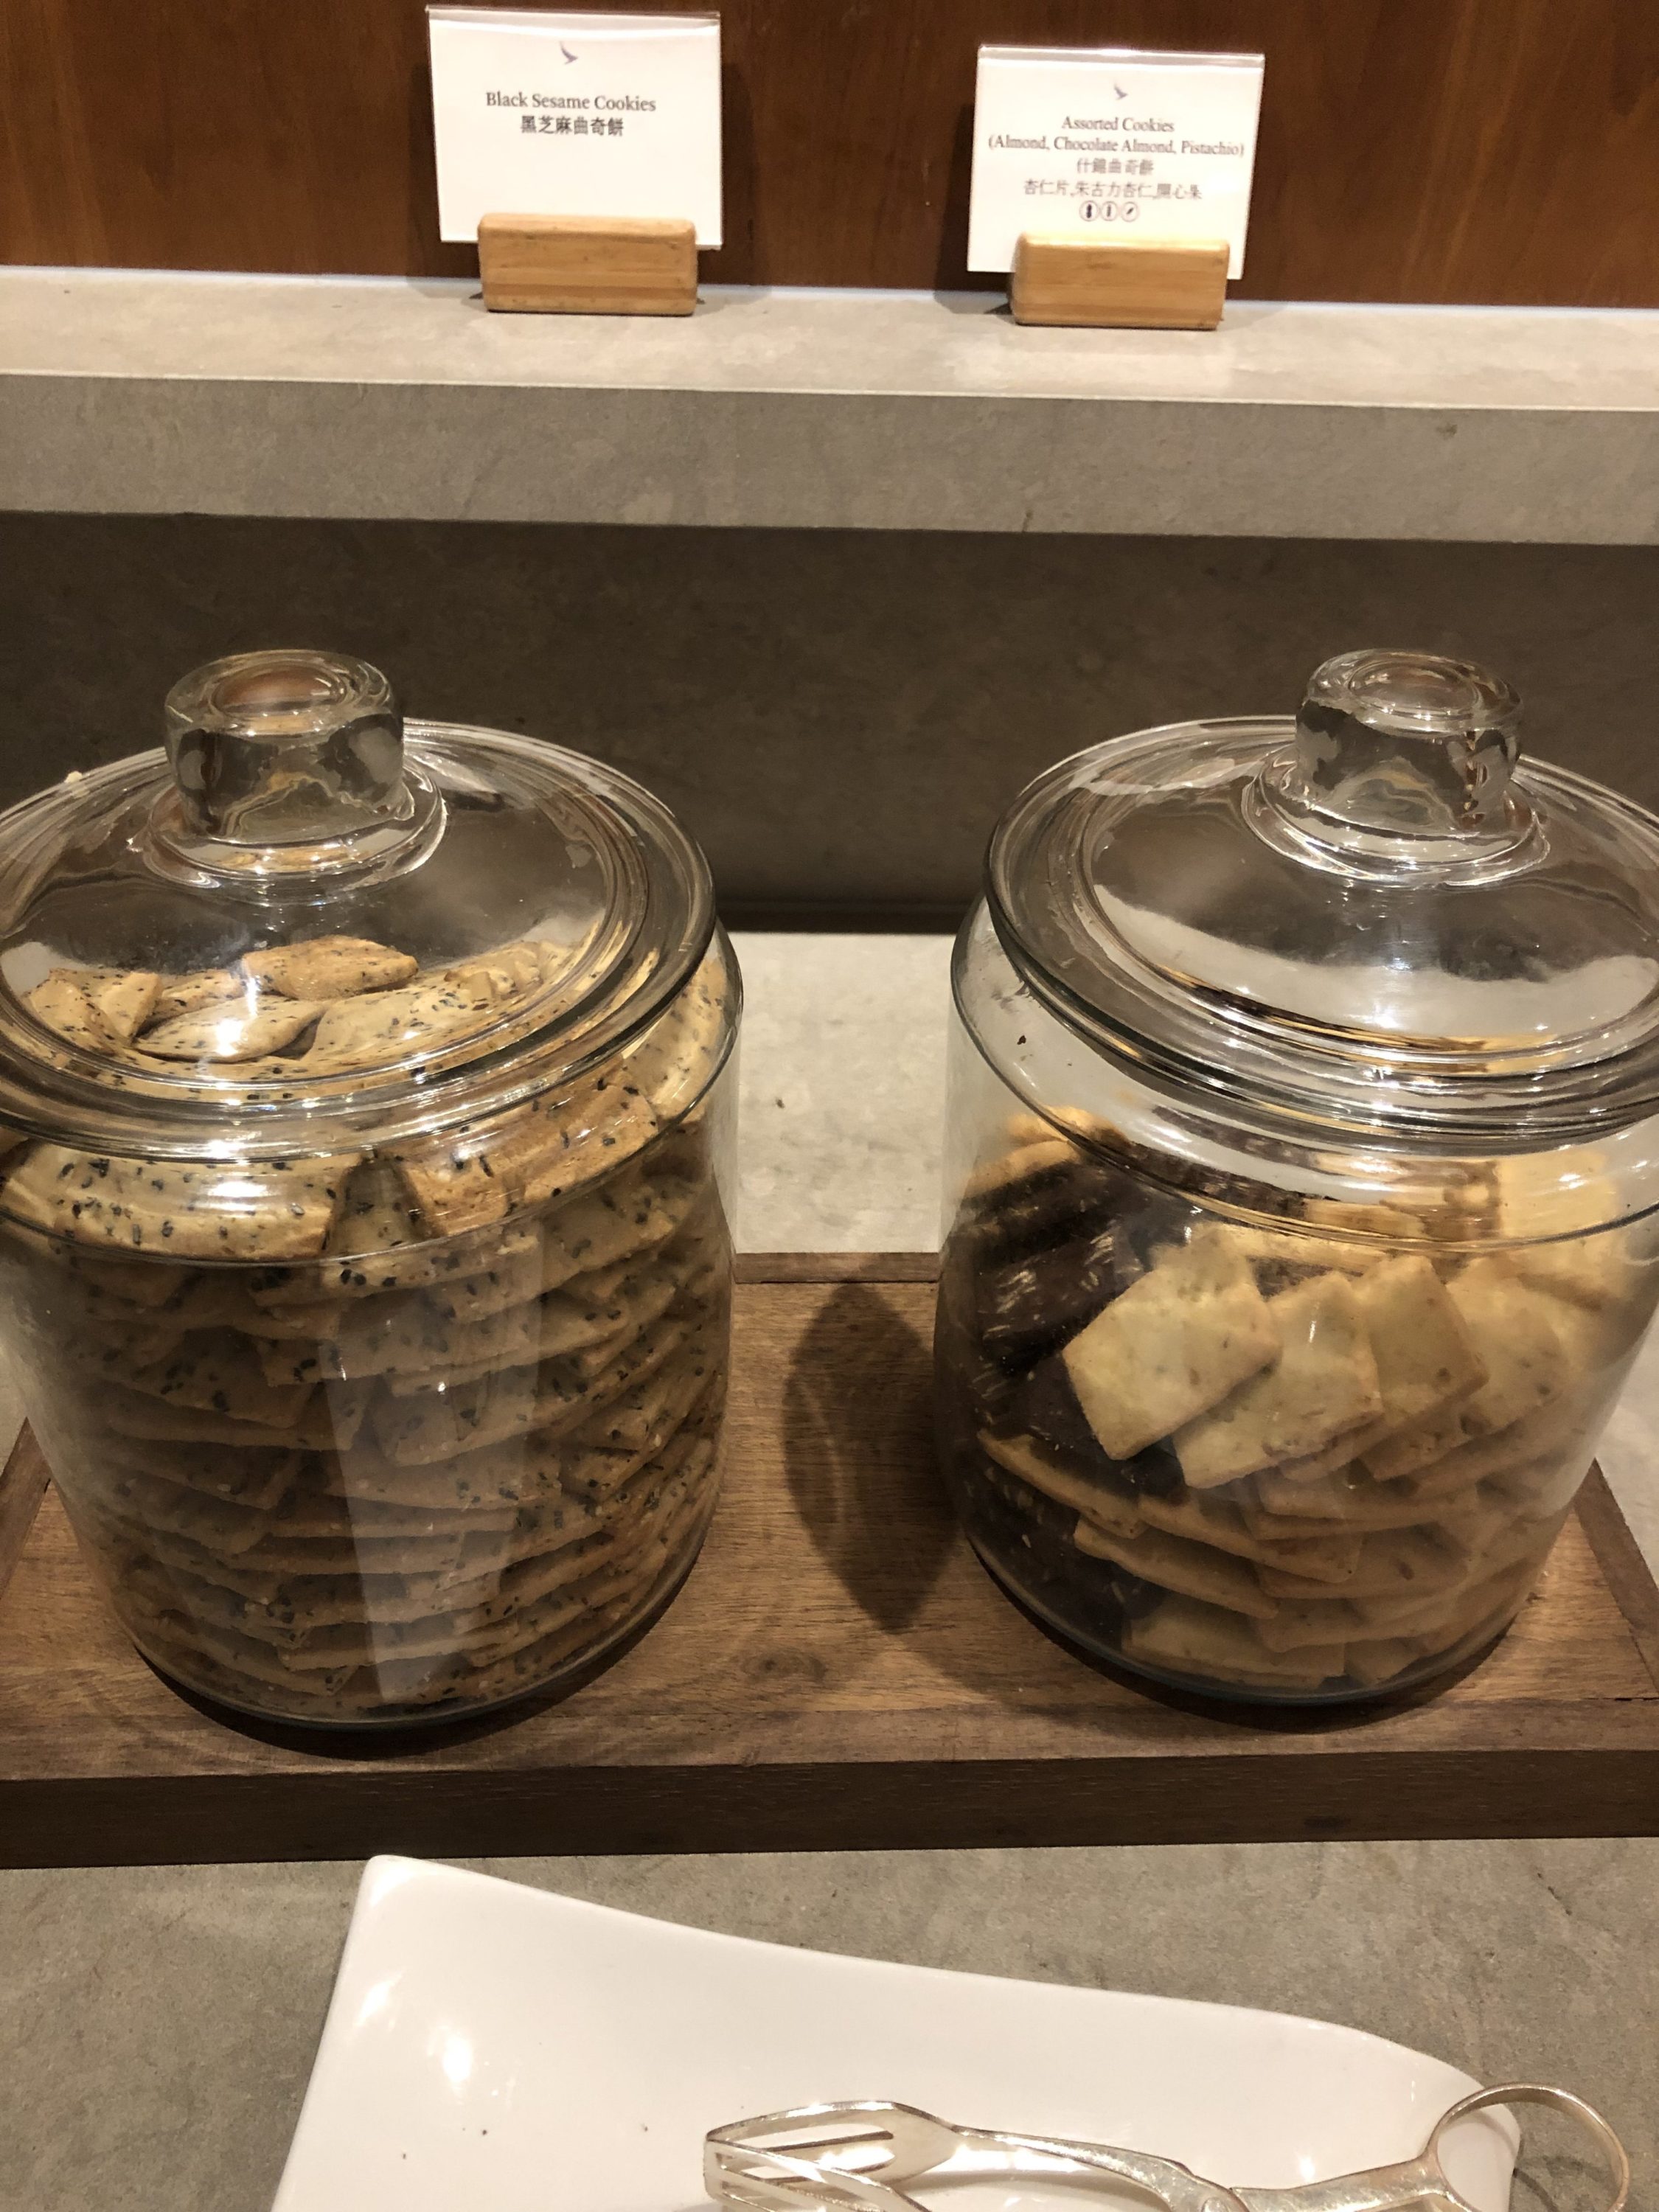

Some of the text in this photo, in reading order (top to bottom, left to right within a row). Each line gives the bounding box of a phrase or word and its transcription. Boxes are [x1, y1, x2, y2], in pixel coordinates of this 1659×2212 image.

[486, 91, 656, 111] Black Sesame Cookies
[521, 115, 624, 136] 黑芝麻曲奇餅
[1062, 116, 1175, 132] Assorted Cookies
[988, 134, 1245, 157] (Almond, Chocolate Almond, Pistachio)
